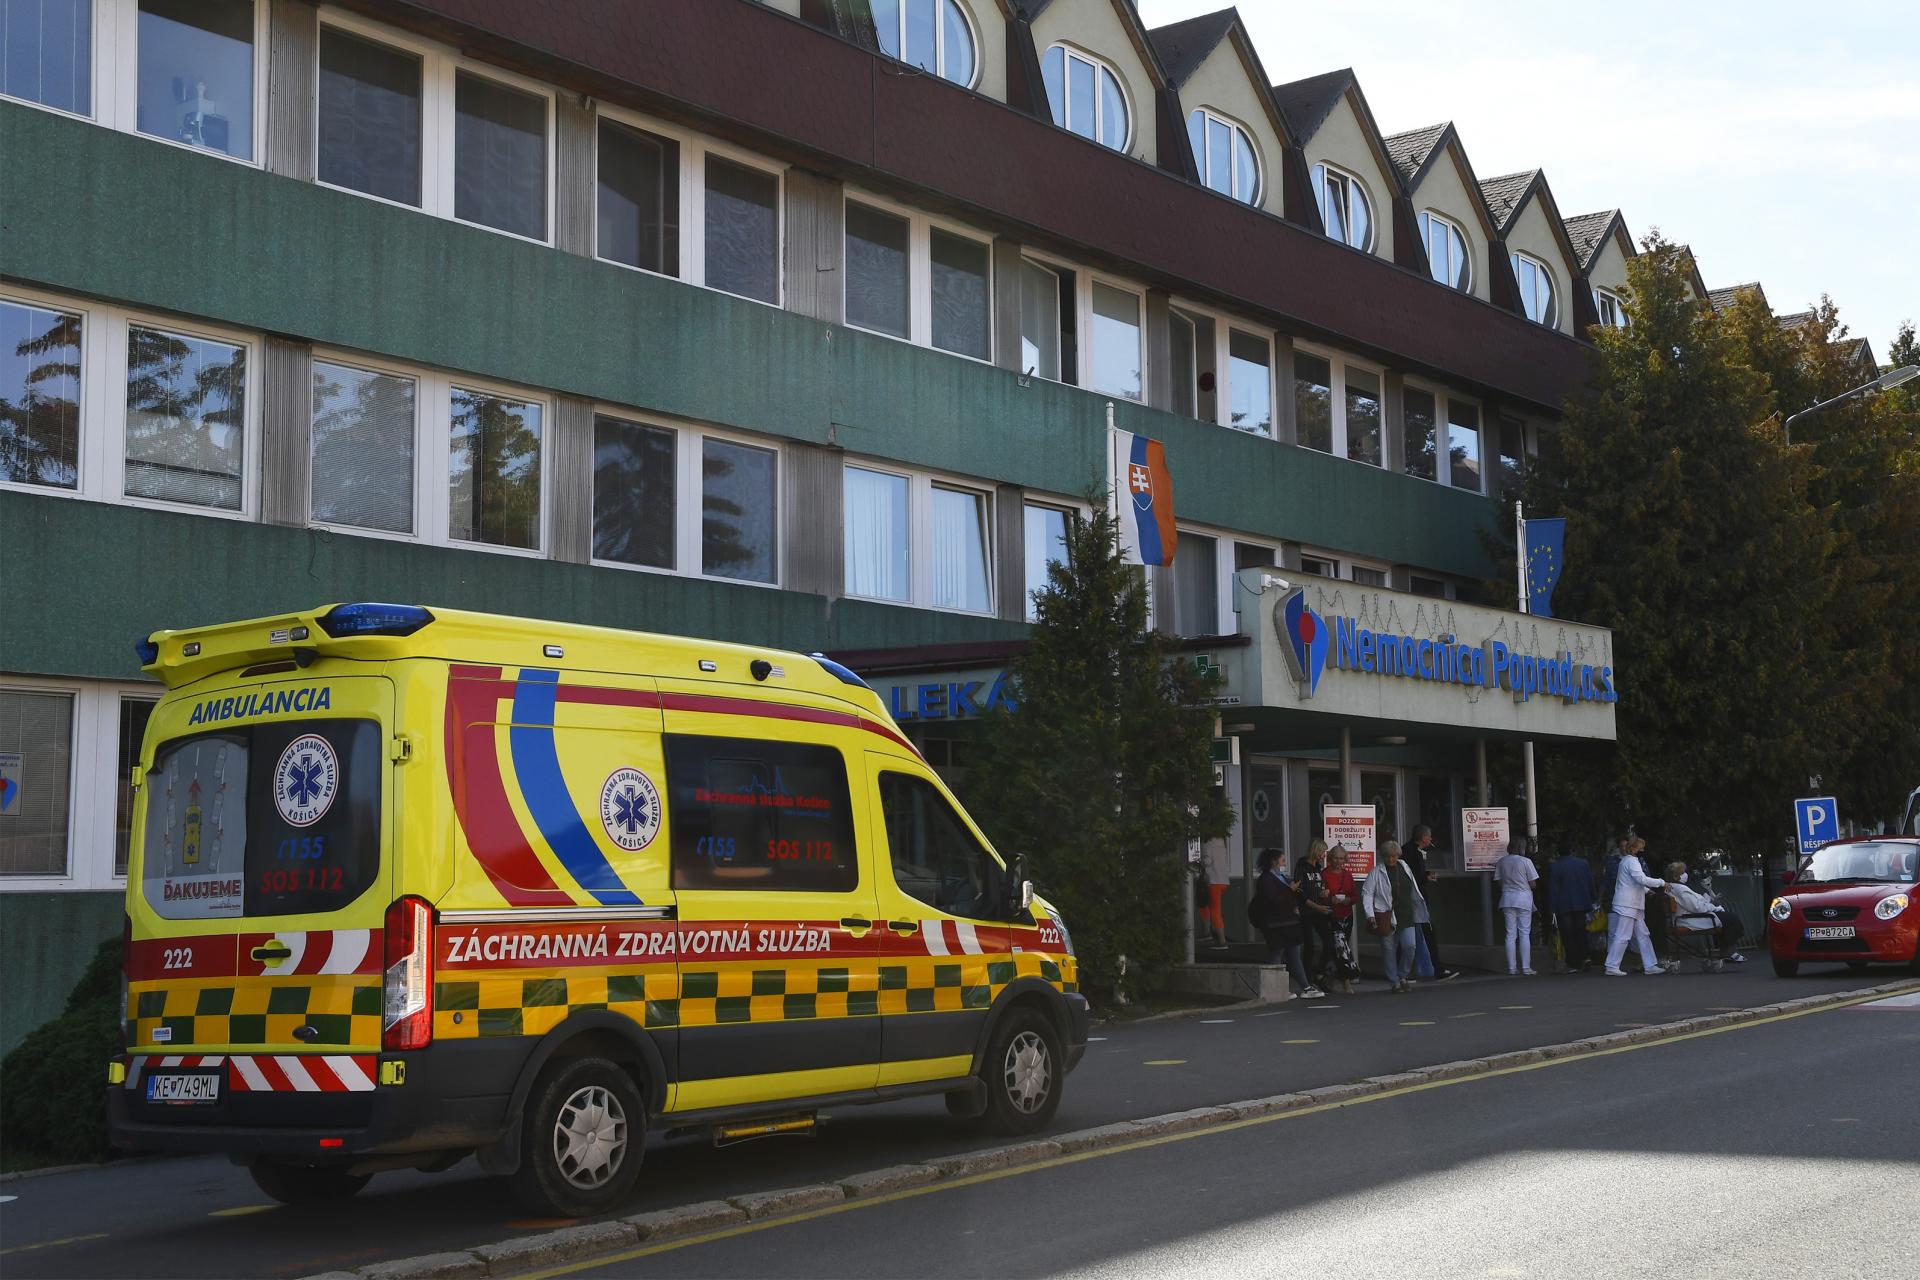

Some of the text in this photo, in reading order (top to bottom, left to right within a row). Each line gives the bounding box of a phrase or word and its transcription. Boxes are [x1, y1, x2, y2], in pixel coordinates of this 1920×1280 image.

[1335, 614, 1485, 686] Nemocnica
[188, 686, 331, 726] AMBULANCIA
[891, 671, 1019, 719] LEKÁ
[277, 740, 335, 802] ZÁCHRANNÁ ZDRAVOTNÁ SLUŽBA
[287, 806, 320, 821] KOŠICE
[603, 772, 659, 828] ZÁCHRANNÁ ZDRAVOTNÁ SLUŽBA
[1806, 805, 1826, 836] P
[288, 836, 324, 859] 155
[616, 834, 648, 848] KOŠICE
[707, 836, 736, 857] 155
[767, 839, 833, 863] SOS 112
[164, 880, 242, 901] ĎAKUJEME
[260, 865, 344, 895] SOS 112
[446, 922, 832, 963] ZÁCHRANNÁ ZDRAVOTNÁ SLUŽBA
[1040, 927, 1060, 944] 222
[163, 947, 193, 969] 222
